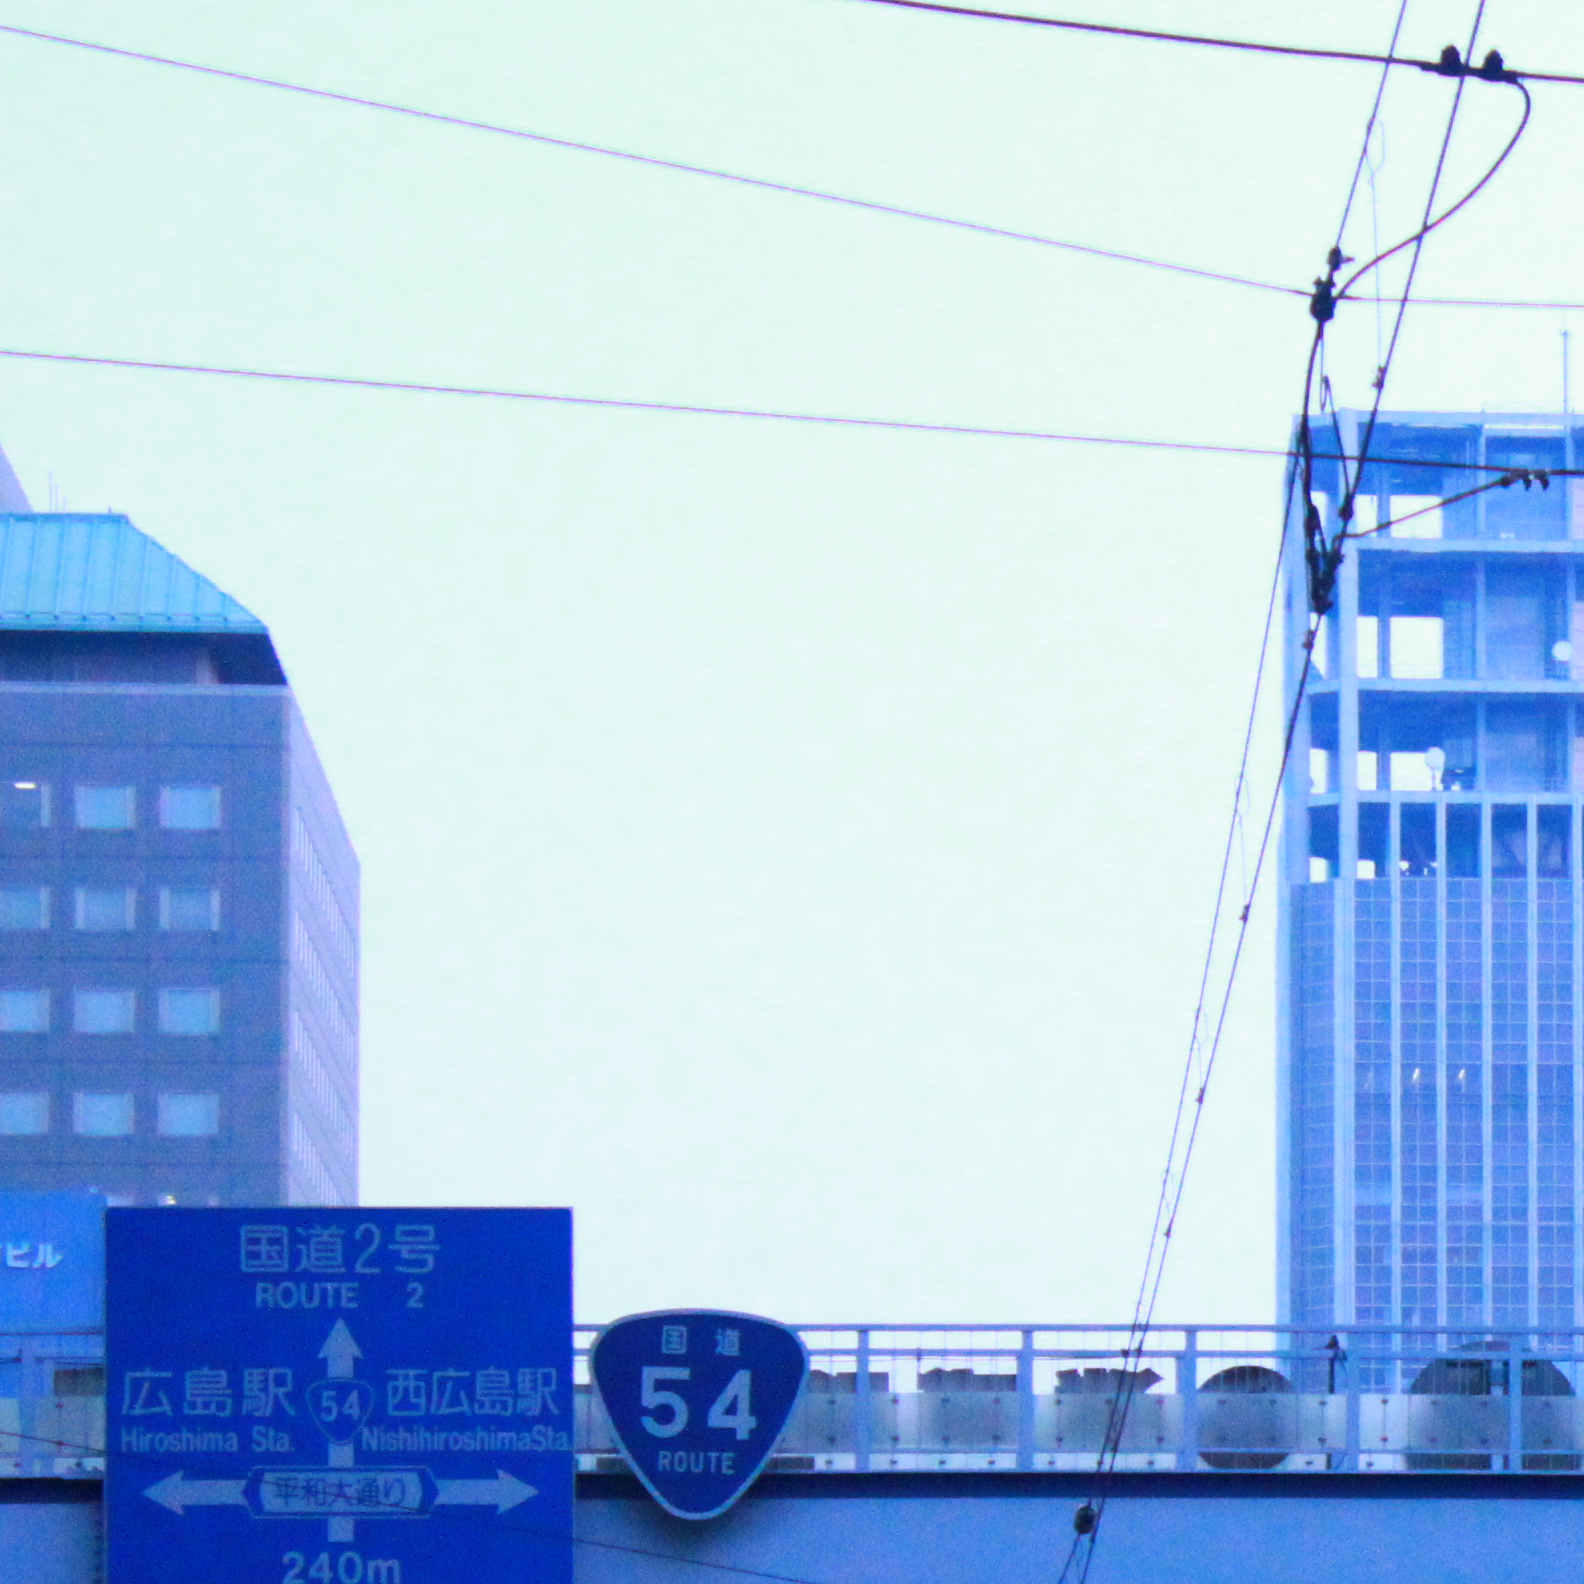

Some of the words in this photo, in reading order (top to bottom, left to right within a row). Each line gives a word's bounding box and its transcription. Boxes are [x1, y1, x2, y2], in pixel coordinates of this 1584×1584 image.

[240, 1223, 441, 1275] 国道2号
[255, 1281, 359, 1309] ROUTE
[406, 1282, 425, 1309] 2
[661, 1325, 741, 1357] 国道
[121, 1366, 297, 1418] 広島駅
[320, 1390, 362, 1421] 54
[385, 1365, 560, 1417] 西広島駅
[640, 1365, 757, 1441] 54
[120, 1426, 238, 1452] Hiroshima
[251, 1426, 295, 1452] Sta.
[657, 1450, 736, 1475] ROUTE
[275, 1477, 404, 1507] 平和大通り
